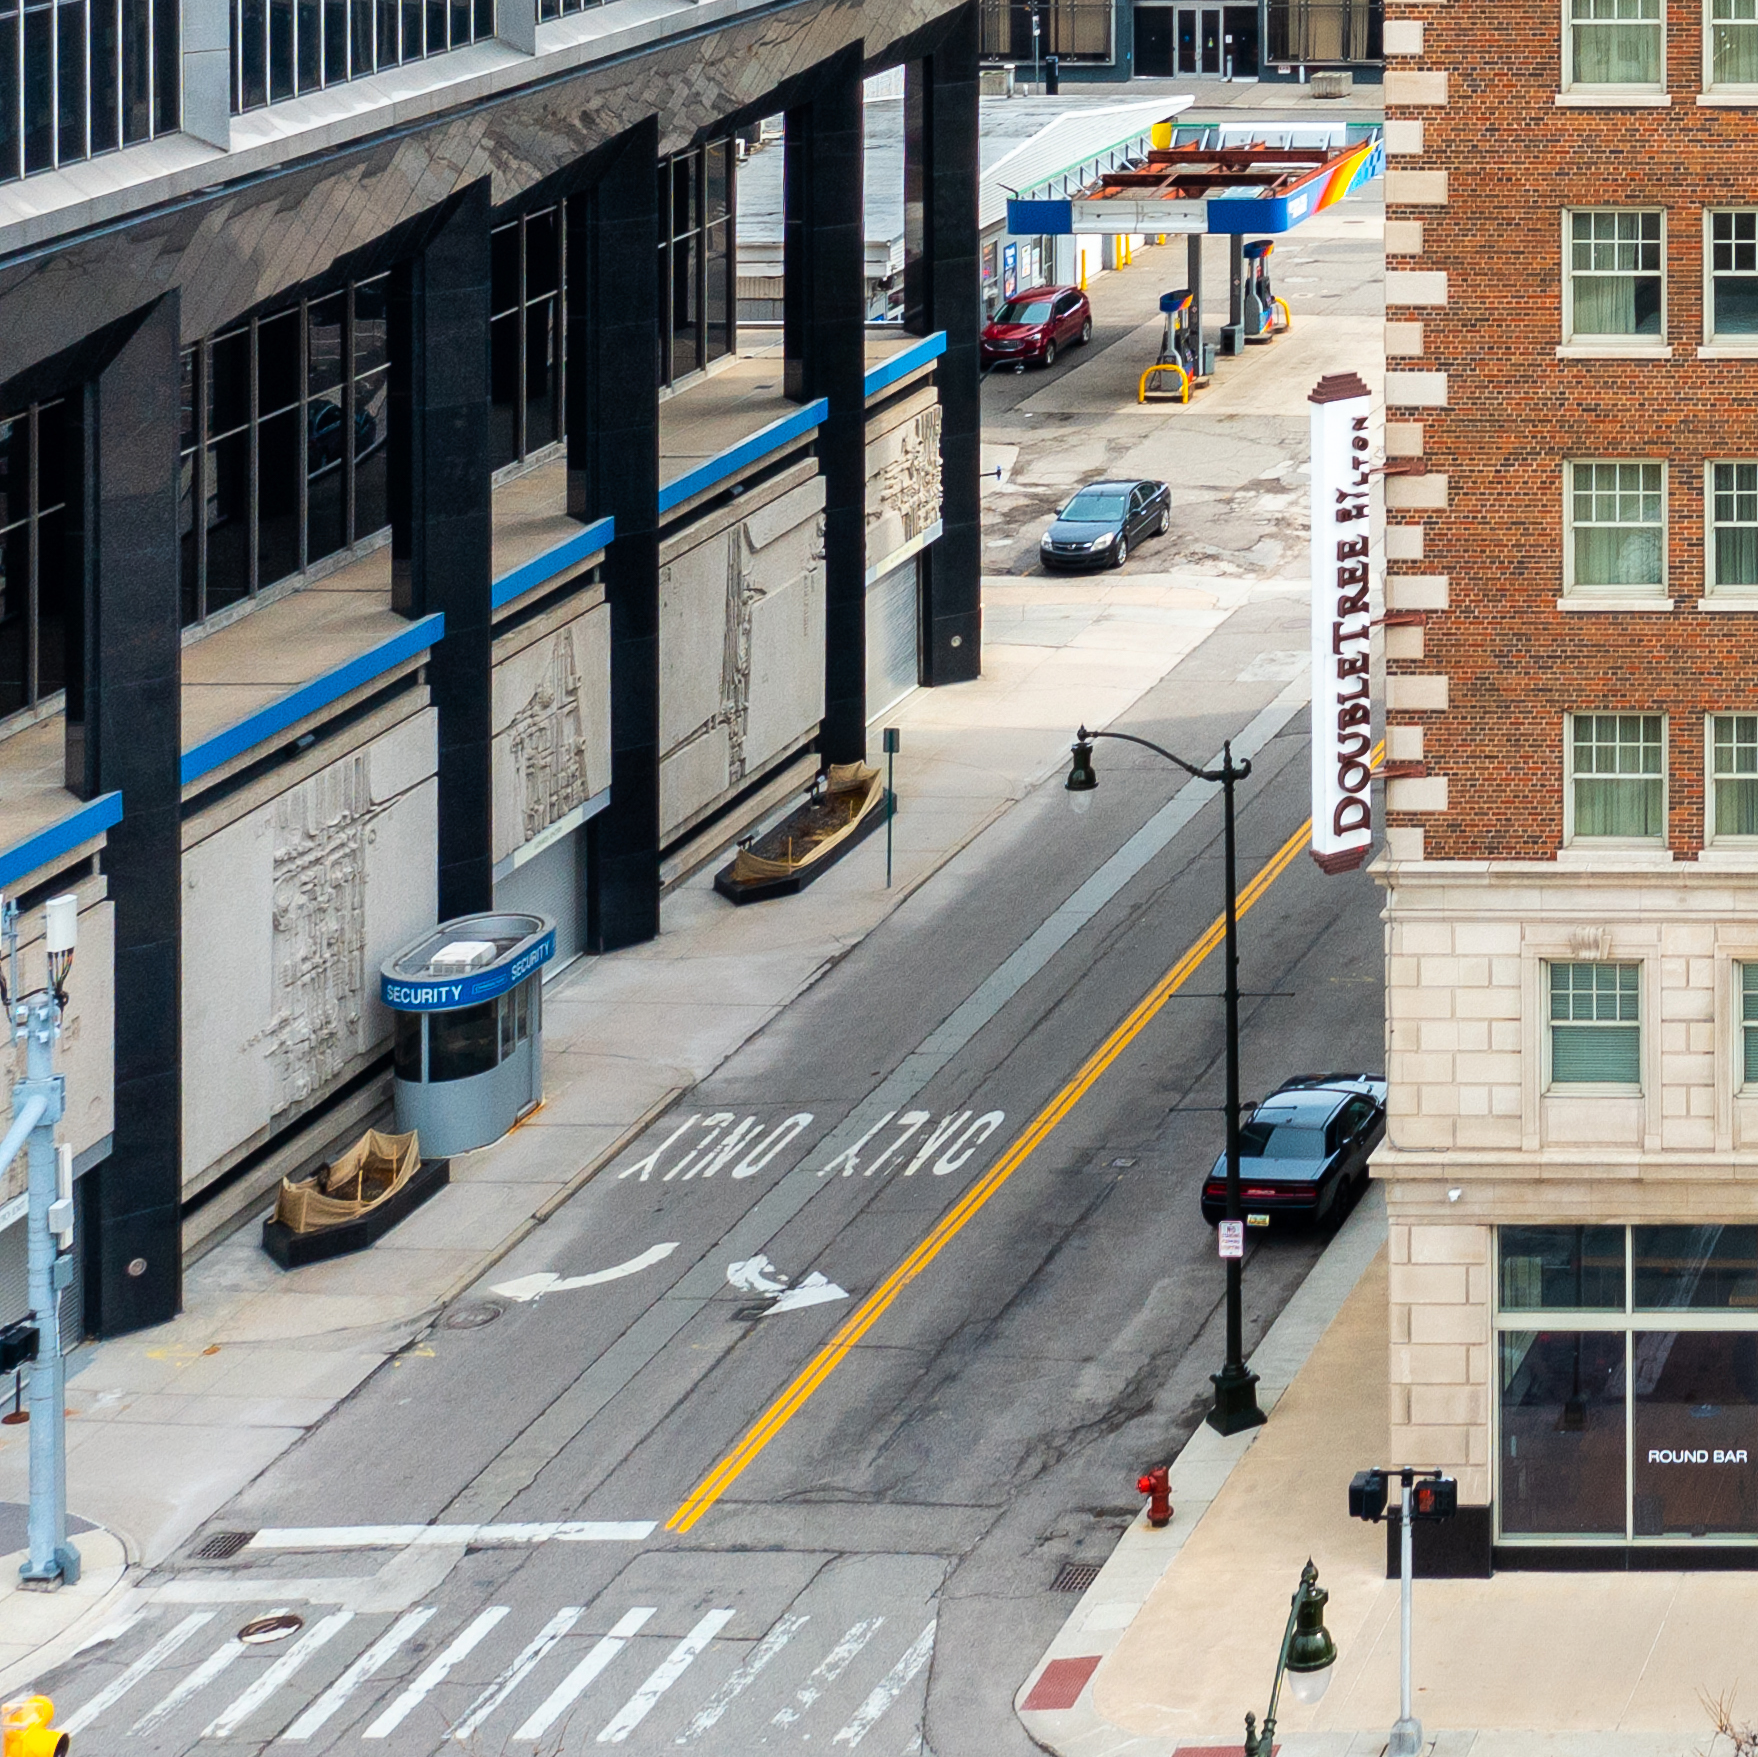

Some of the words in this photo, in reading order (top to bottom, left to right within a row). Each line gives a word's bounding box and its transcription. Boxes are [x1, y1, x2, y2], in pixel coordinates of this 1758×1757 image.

[1352, 415, 1370, 520] HILTON
[1335, 487, 1353, 523] BY
[1333, 534, 1371, 837] DOUBLETREE
[511, 940, 550, 980] SECURITY
[386, 984, 463, 1004] SECURITY
[1648, 1449, 1709, 1463] ROUND
[1713, 1449, 1748, 1463] BAR
